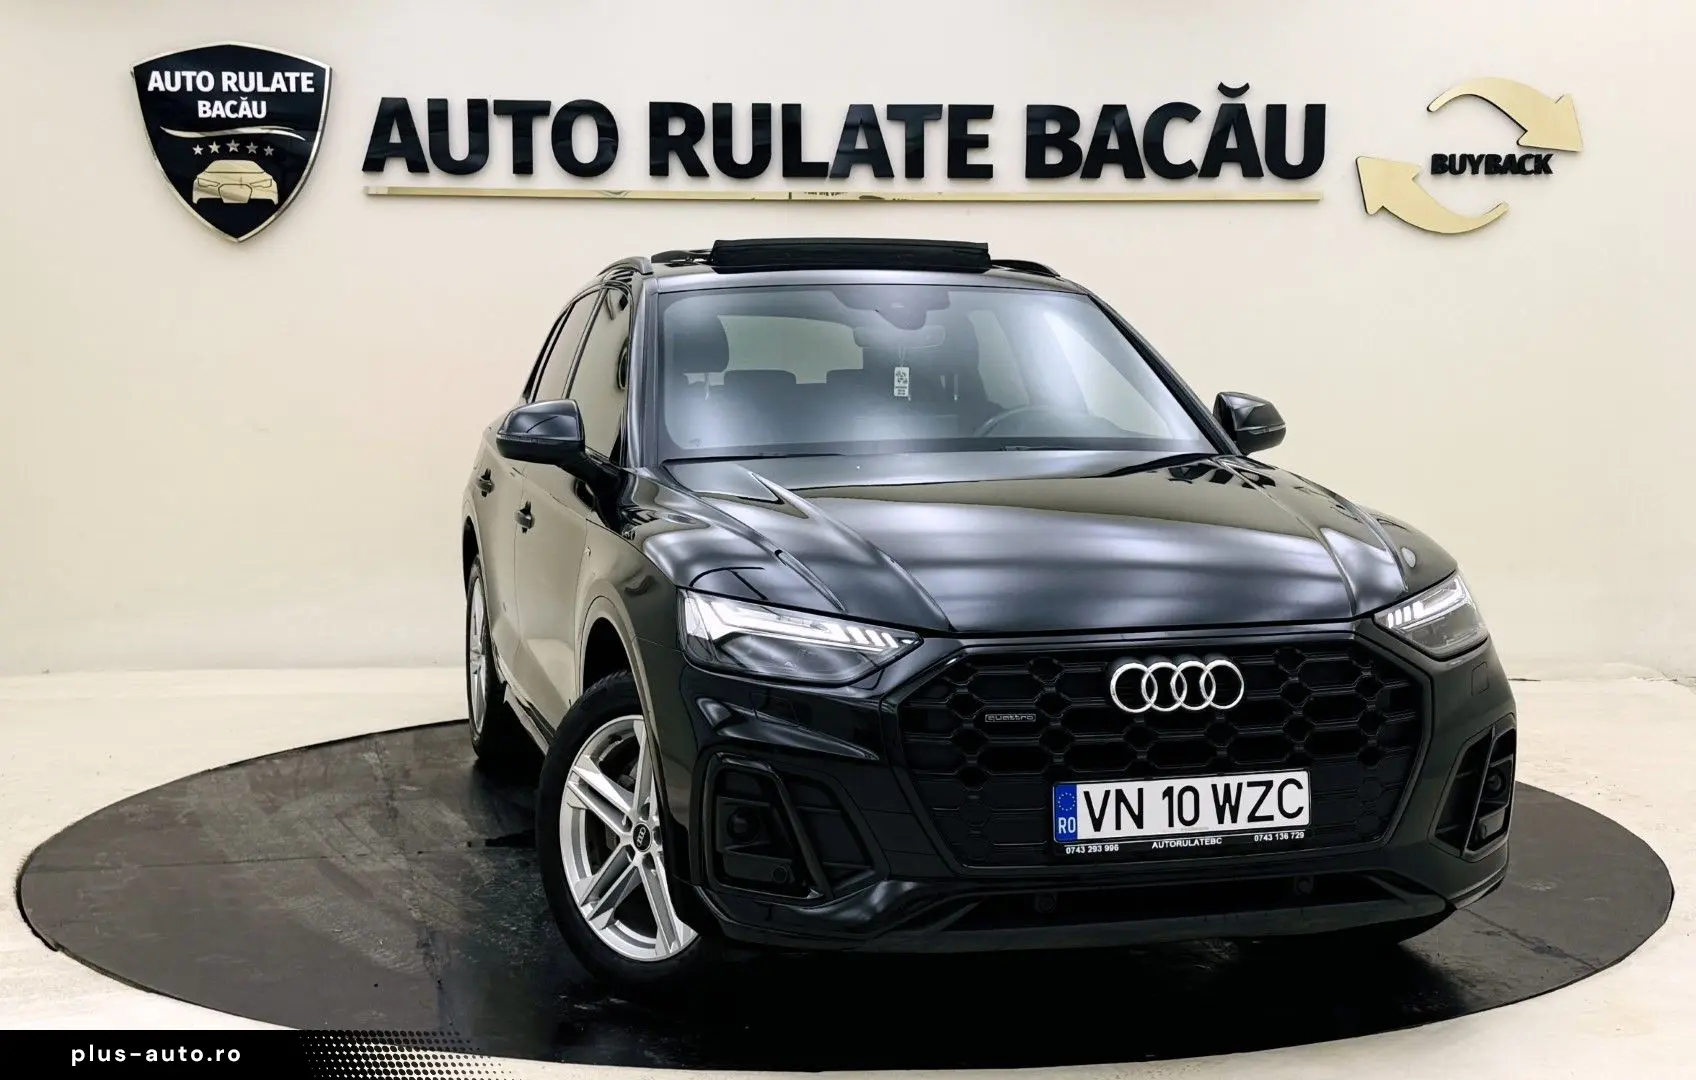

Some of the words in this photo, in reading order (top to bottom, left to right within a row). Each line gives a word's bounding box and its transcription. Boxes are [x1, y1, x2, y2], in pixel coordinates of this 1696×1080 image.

[147, 70, 215, 92] AUTO
[221, 71, 315, 93] RULATE
[197, 96, 267, 119] BACĂU
[361, 97, 619, 178] AUTO
[648, 101, 994, 179] RULATE
[1025, 81, 1326, 180] BACĂU
[1430, 153, 1554, 175] BUYBACK
[986, 714, 1034, 722] quattro
[1083, 787, 1144, 833] VN
[1162, 785, 1200, 828] 10
[1211, 778, 1304, 825] WZC
[1058, 816, 1076, 834] RO
[1151, 838, 1223, 849] AUTORULATEBC
[1254, 833, 1273, 842] 0743
[1290, 831, 1305, 839] 729
[1065, 845, 1086, 854] 0743
